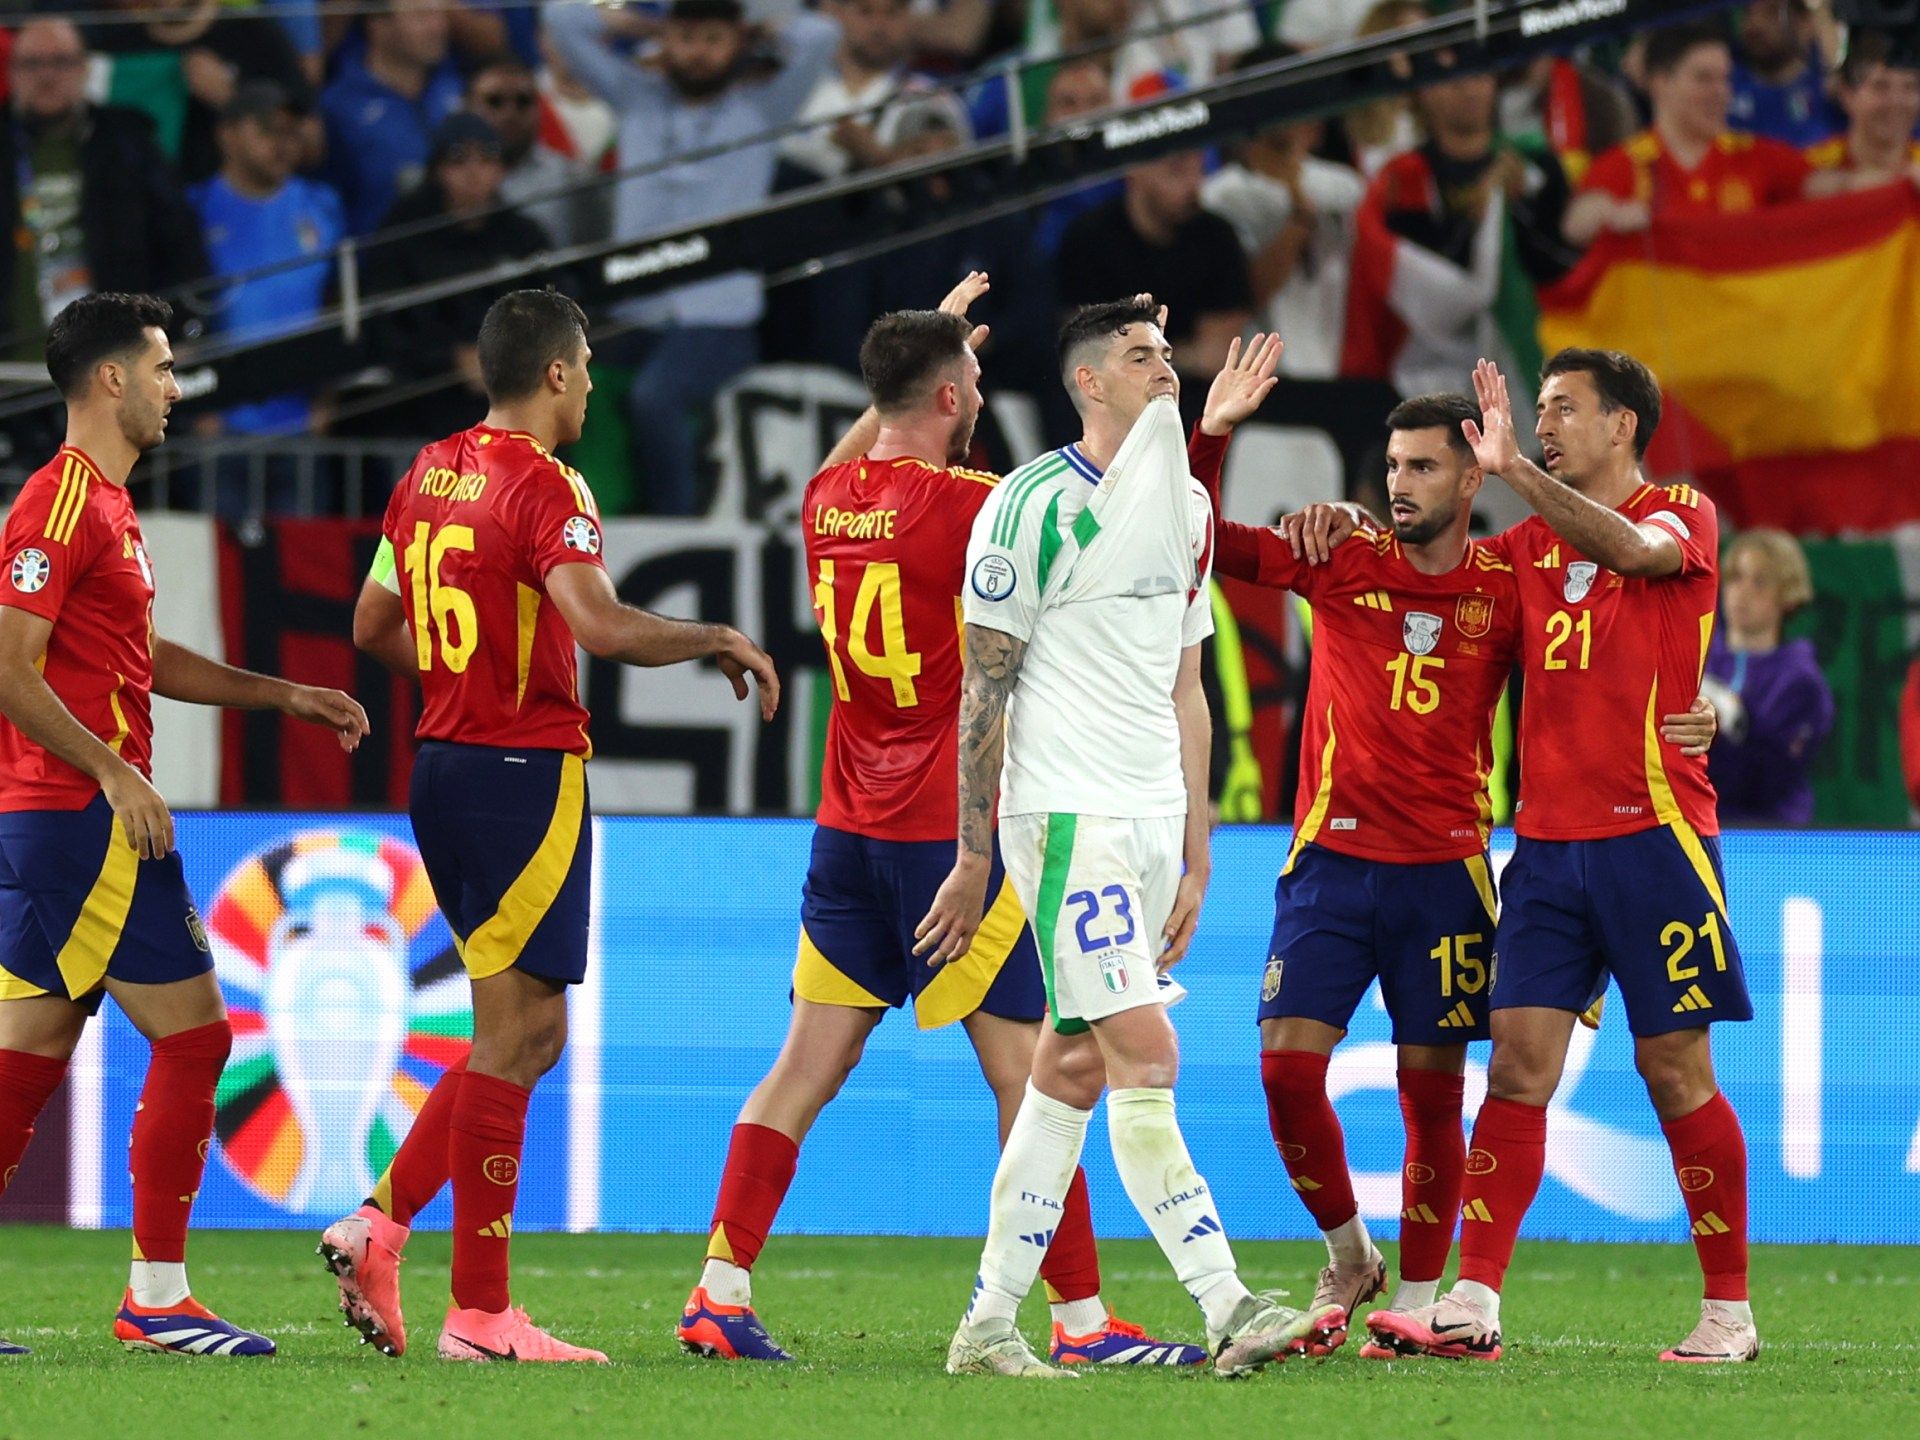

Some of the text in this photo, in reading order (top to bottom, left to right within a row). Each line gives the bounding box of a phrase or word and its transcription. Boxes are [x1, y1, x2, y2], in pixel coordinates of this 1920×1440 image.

[815, 504, 897, 539] LAPORTE
[404, 520, 478, 674] 16
[814, 558, 921, 708] 14
[1544, 609, 1591, 670] 21
[1385, 651, 1445, 715] 15
[1066, 884, 1135, 954] 23
[1660, 911, 1727, 982] 21
[1430, 932, 1486, 997] 15
[1154, 1185, 1207, 1215] ITALIA
